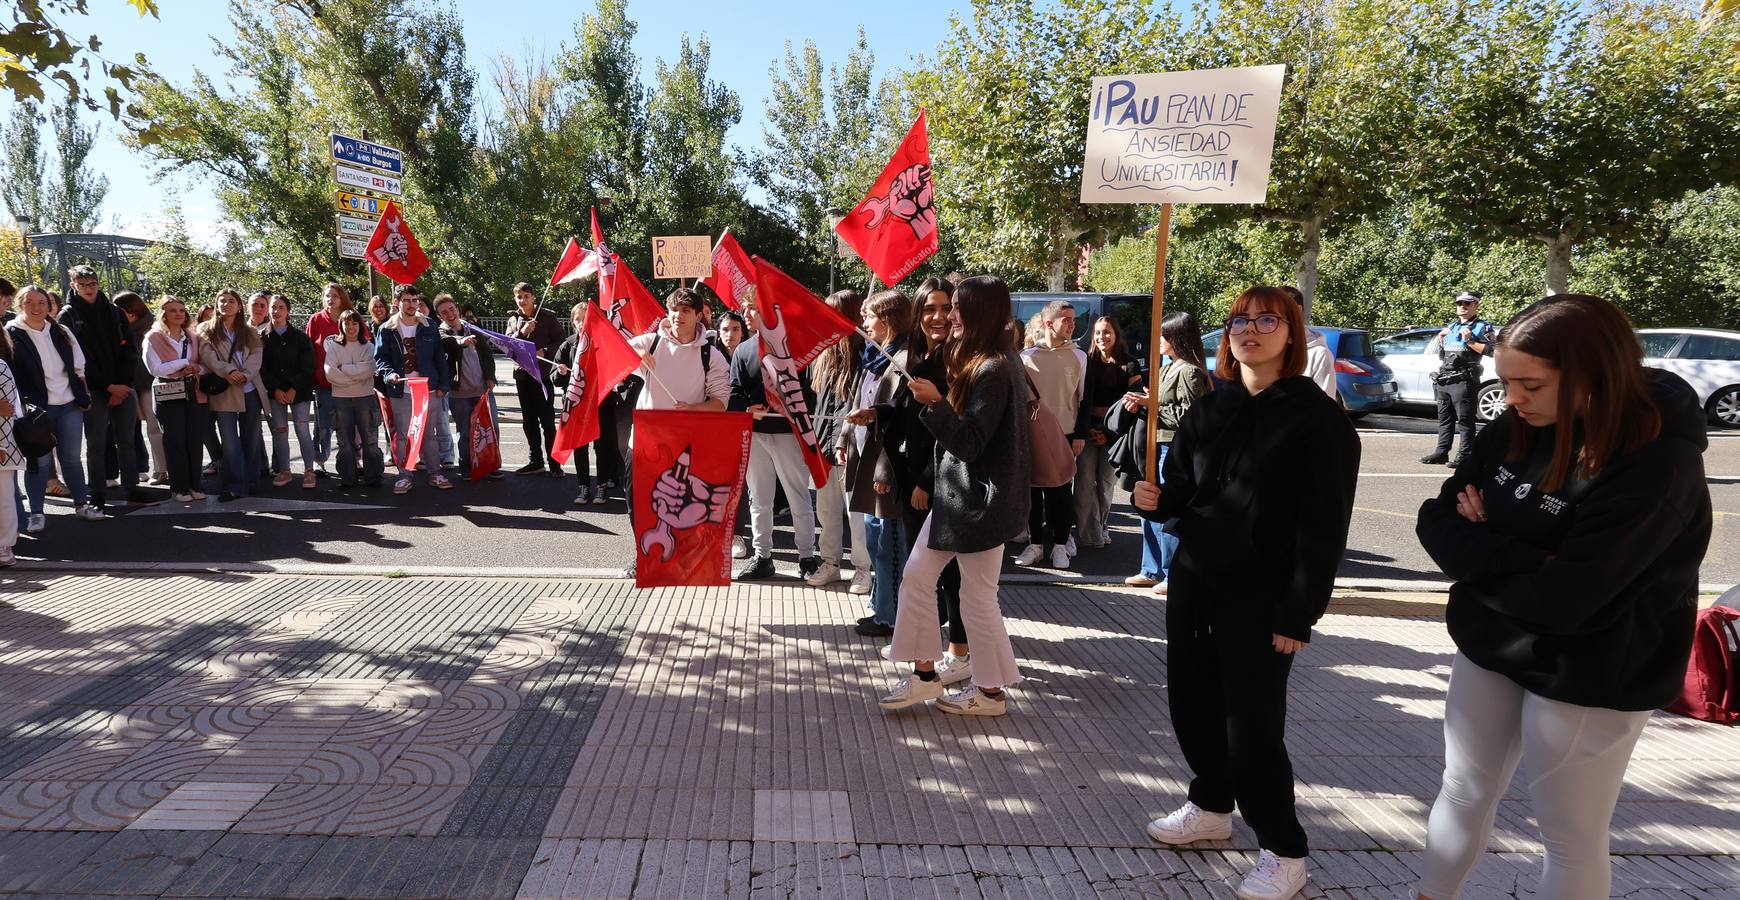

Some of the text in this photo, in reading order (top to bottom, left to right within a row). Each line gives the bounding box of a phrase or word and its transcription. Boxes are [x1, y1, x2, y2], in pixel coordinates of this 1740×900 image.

[1166, 93, 1217, 124] PLAN
[1221, 93, 1255, 122] DE
[1125, 130, 1232, 154] ANSIEDAD
[371, 146, 400, 161] Valladolid
[372, 156, 392, 168] Burgos
[338, 170, 370, 183] SANTANDER
[1101, 156, 1239, 188] UNIVERSITARIA!
[656, 239, 705, 254] PLAN DE
[656, 254, 706, 267] ANSIEDAD
[888, 246, 932, 283] Sindicato
[1540, 503, 1560, 516] STYLE
[1544, 500, 1562, 511] YOUR
[720, 519, 735, 580] Sindicato
